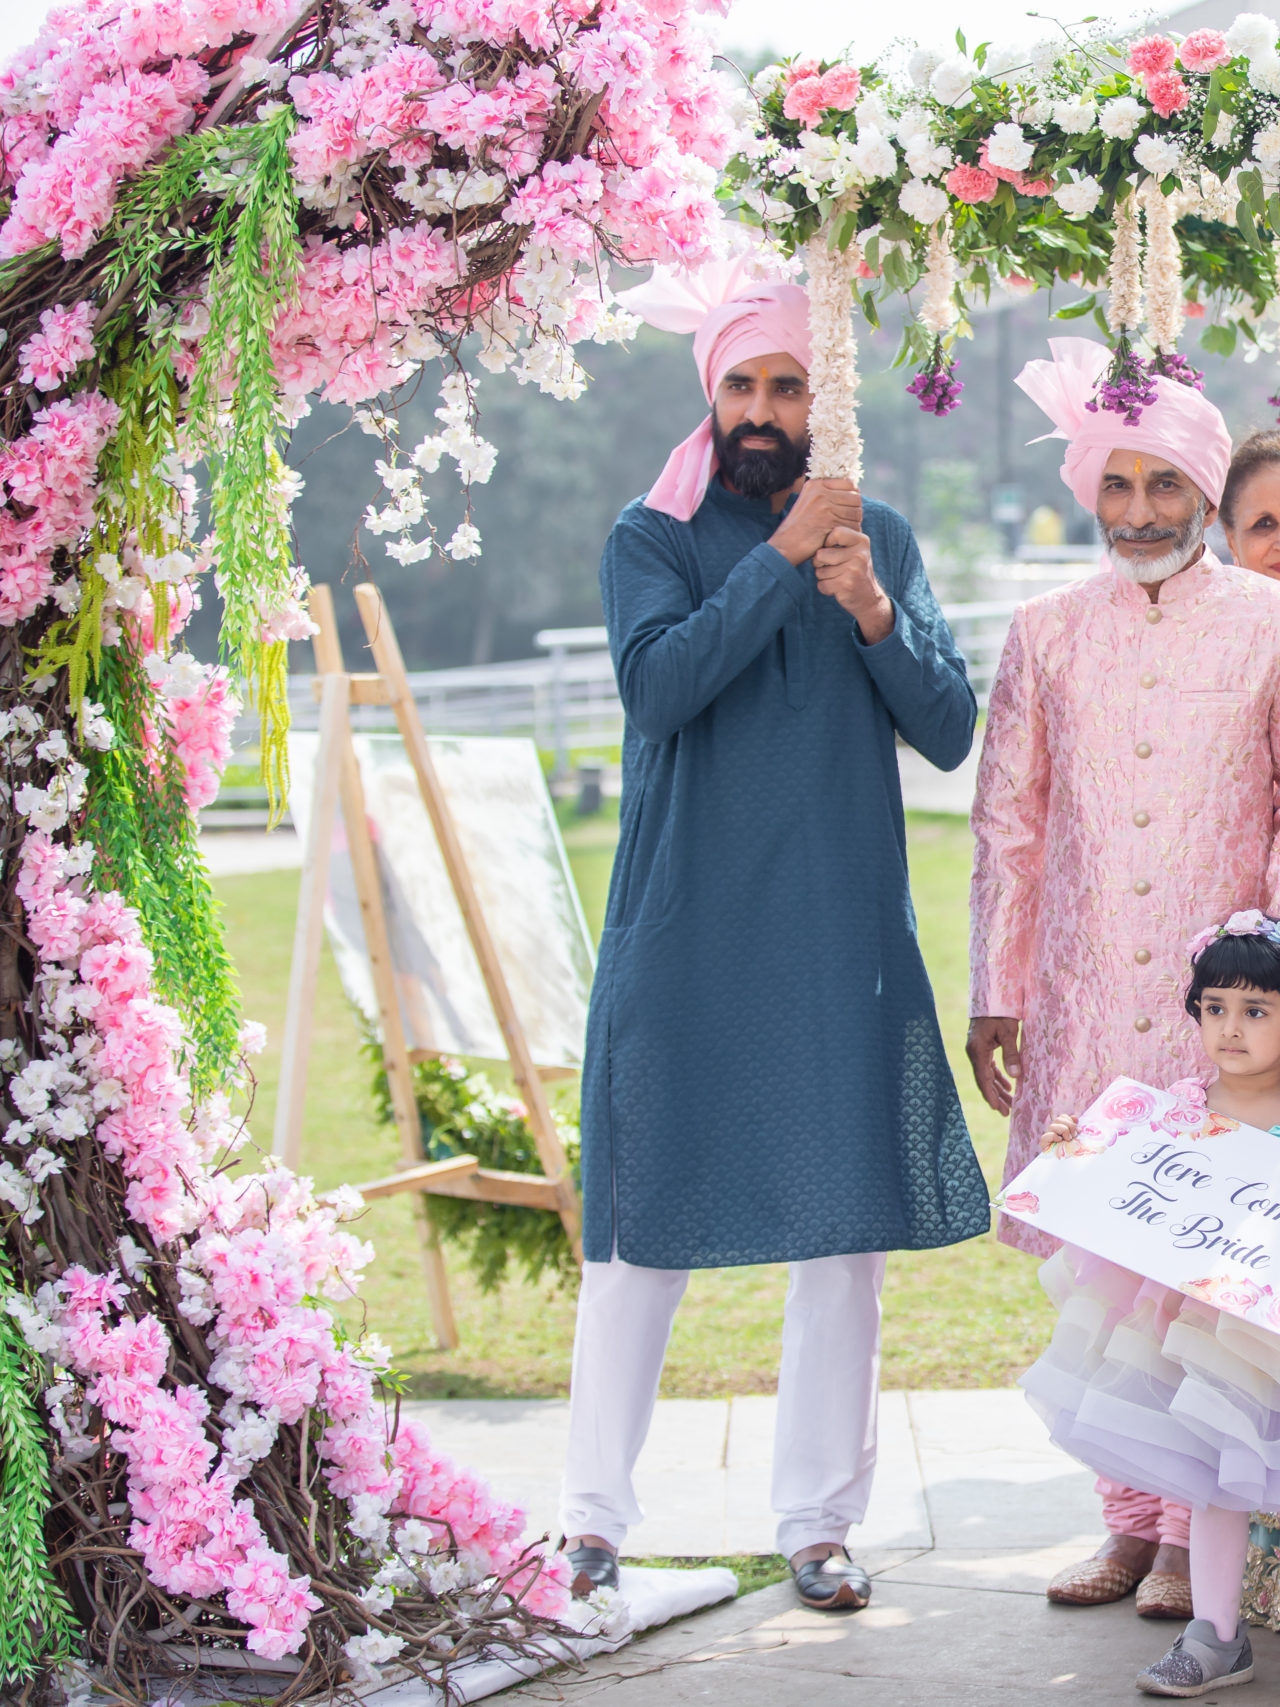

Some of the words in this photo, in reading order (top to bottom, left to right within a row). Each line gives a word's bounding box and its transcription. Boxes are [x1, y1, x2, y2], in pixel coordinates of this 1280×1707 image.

[1131, 1142, 1212, 1189] Here
[1109, 1181, 1178, 1225] The
[1170, 1213, 1271, 1269] Bride
